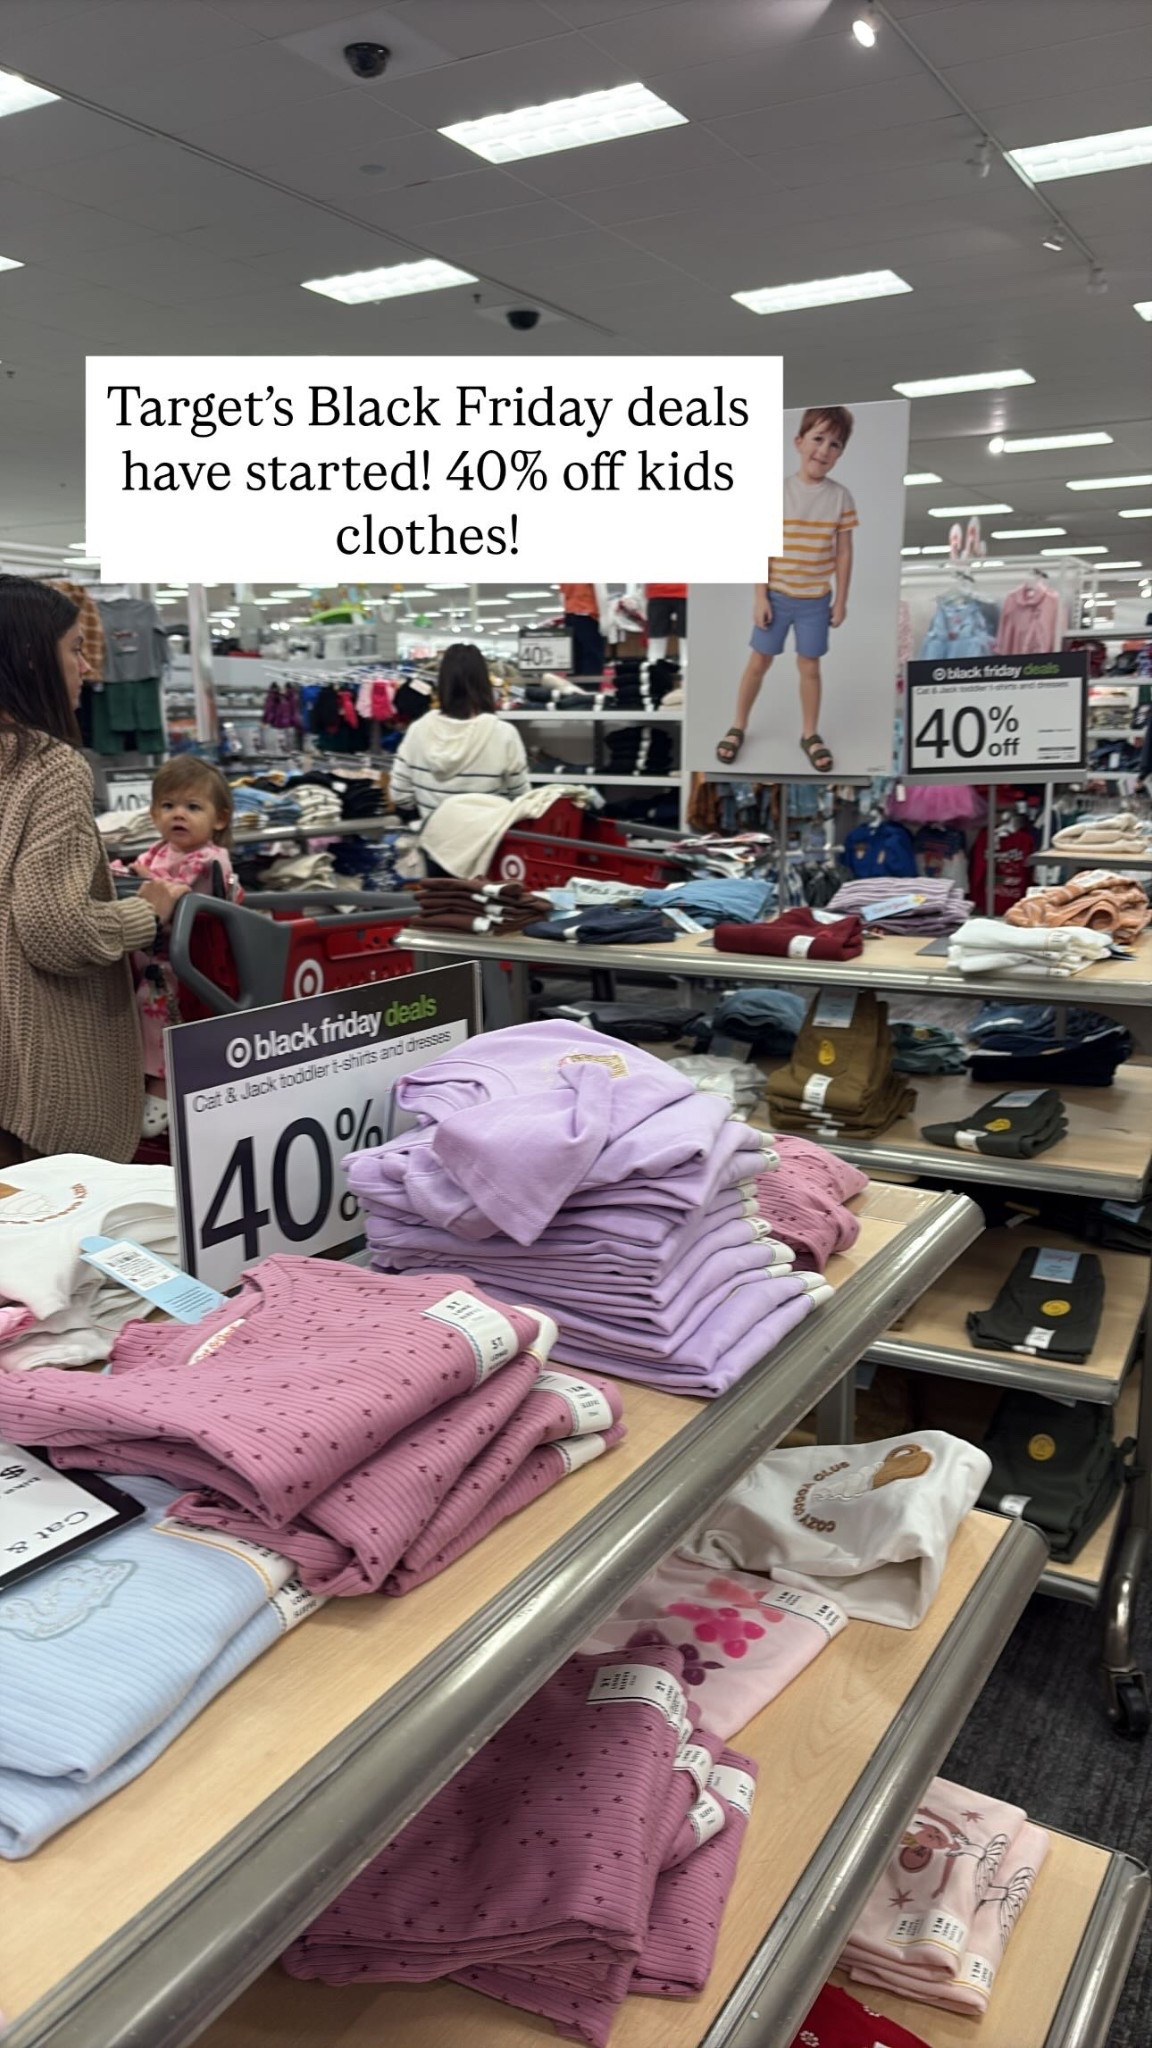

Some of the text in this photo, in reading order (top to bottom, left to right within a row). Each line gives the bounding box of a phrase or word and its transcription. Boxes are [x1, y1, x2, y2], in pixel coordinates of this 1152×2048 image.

[947, 662, 1060, 680] black friday deals
[916, 687, 930, 695] Cat
[939, 685, 957, 694] Jack
[1019, 681, 1036, 690] and
[988, 737, 1020, 757] off
[254, 994, 437, 1062] black friday deals
[192, 1030, 452, 1113] Cat & Jack toddler t-shirts and dresses
[0, 1464, 27, 1480] $
[4, 1511, 89, 1554] Cat &
[798, 1513, 836, 1533] COZY
